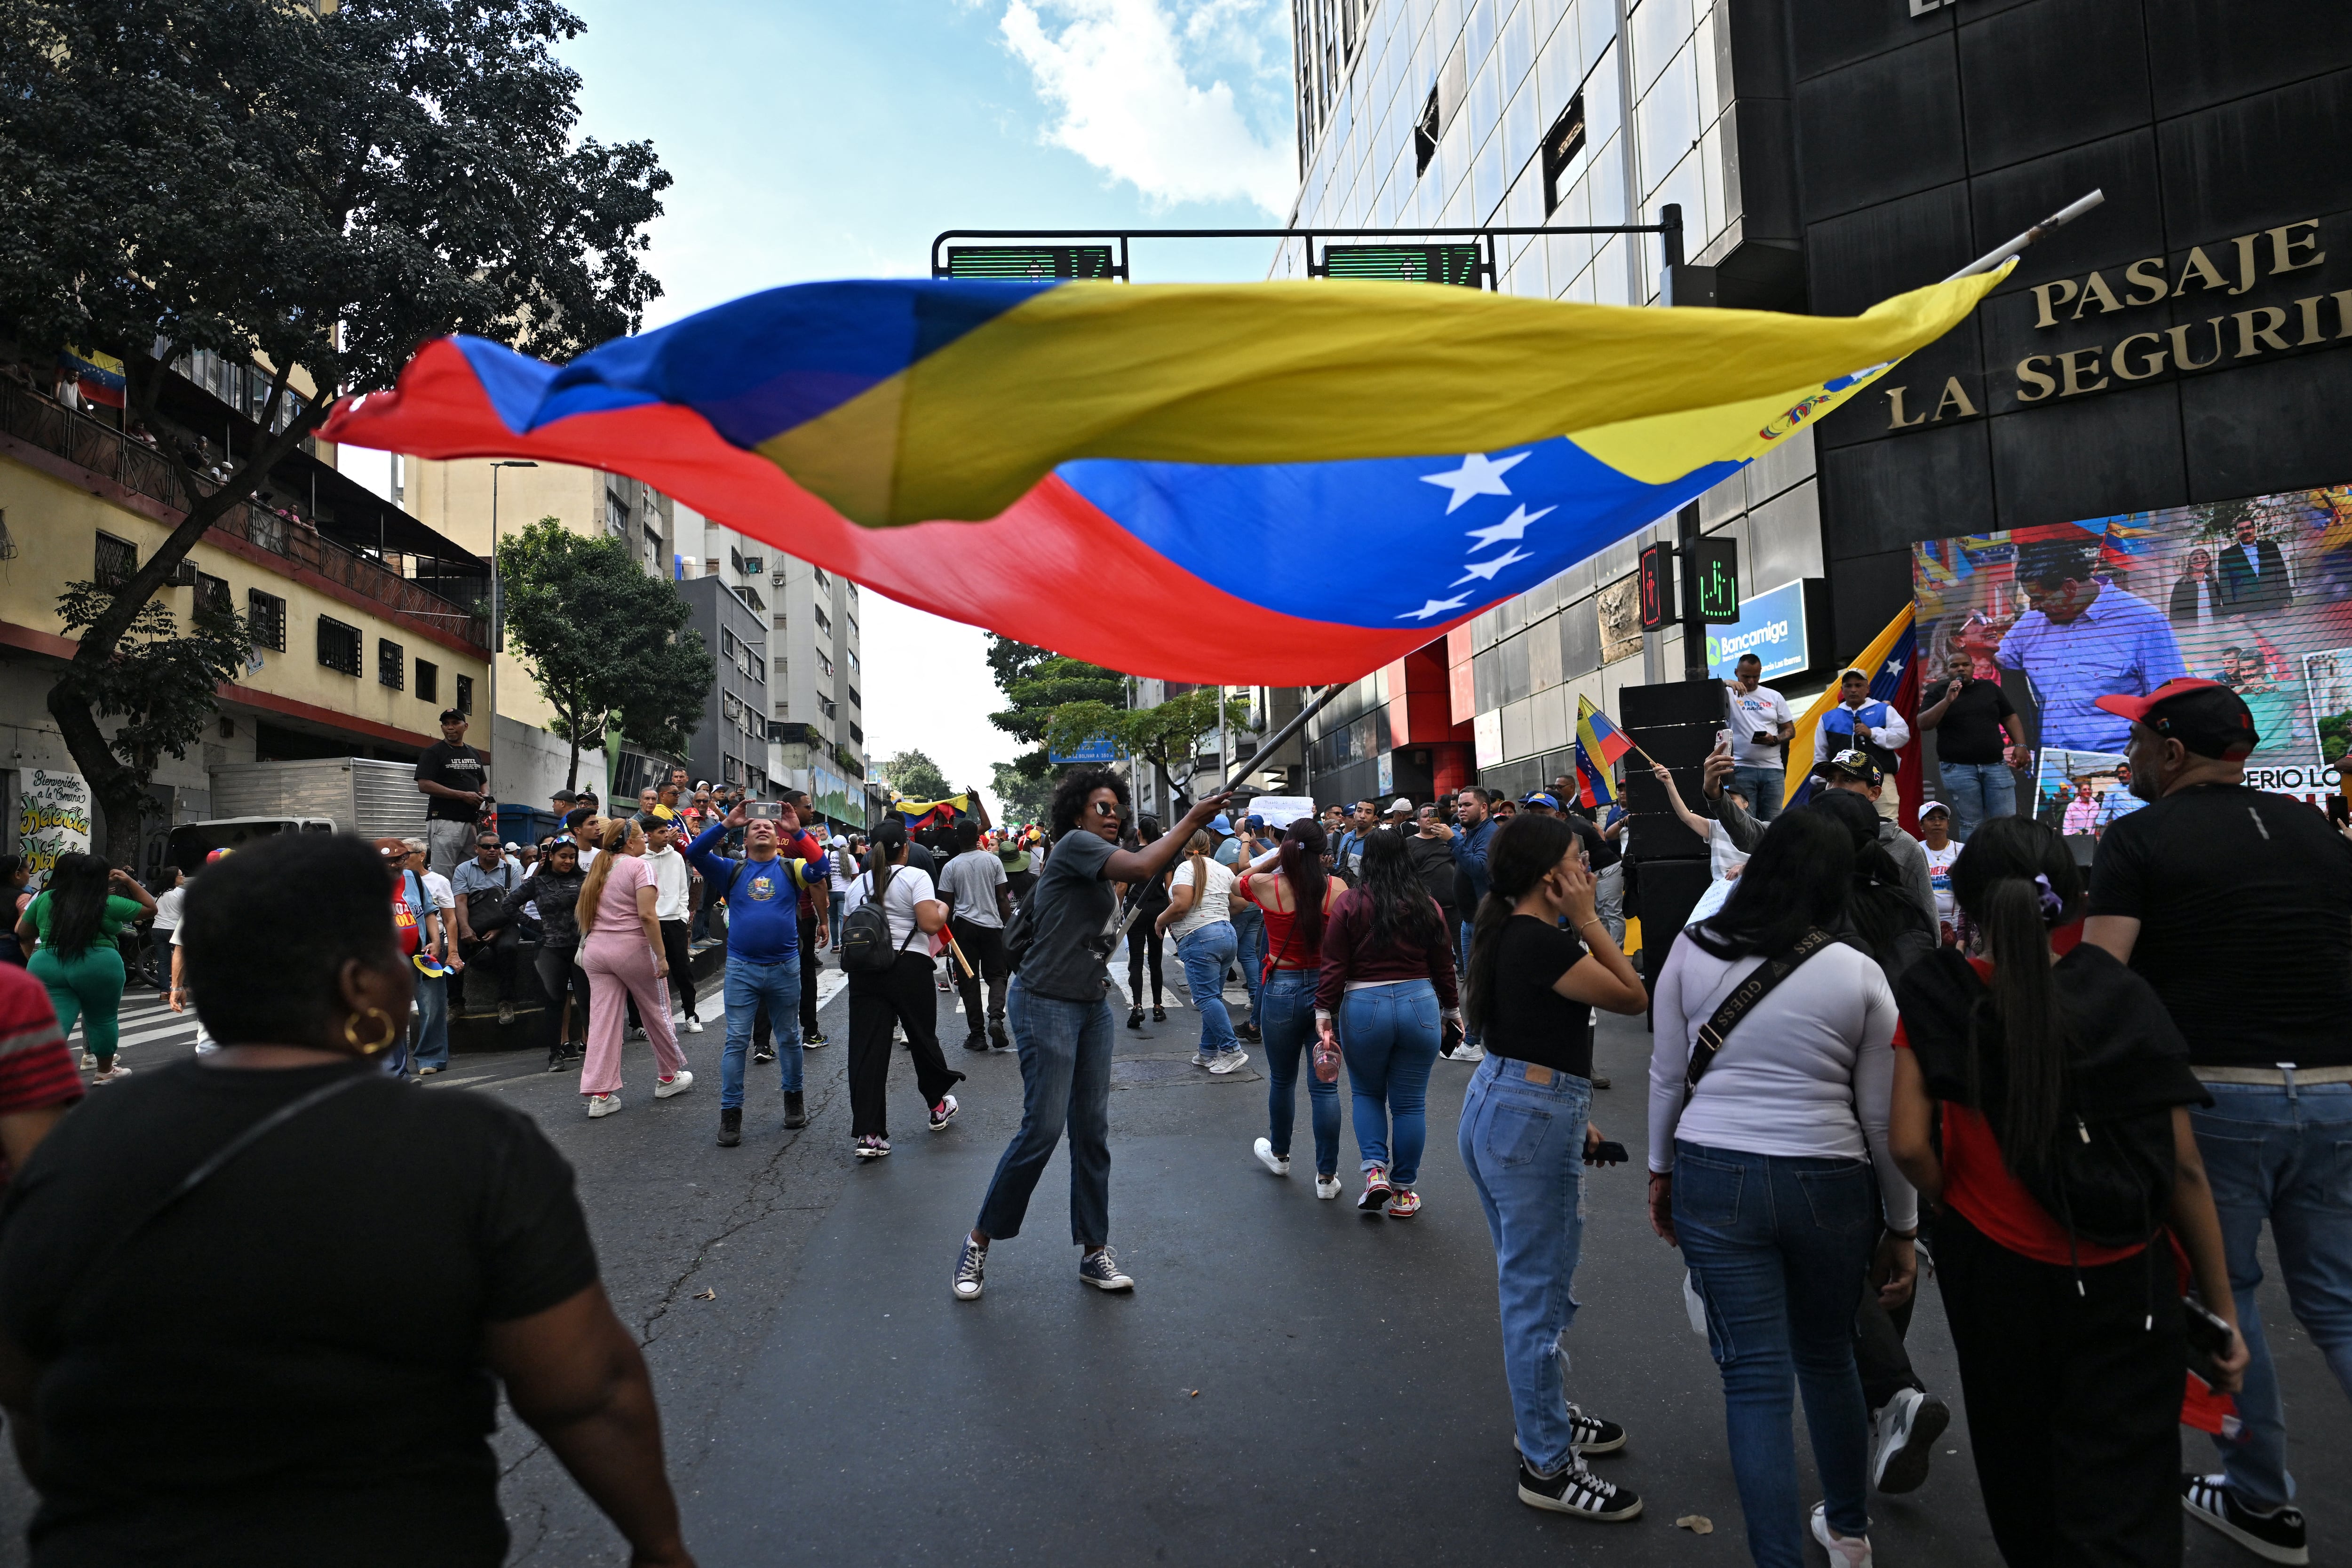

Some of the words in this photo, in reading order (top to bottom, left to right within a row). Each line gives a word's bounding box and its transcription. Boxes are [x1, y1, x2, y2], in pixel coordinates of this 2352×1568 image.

[2031, 218, 2325, 329] PASAJE
[1886, 377, 1979, 430] LA
[1721, 620, 1788, 655] Bancamiga
[33, 770, 83, 792] Bienvenidos
[46, 787, 52, 800] la
[54, 787, 86, 803] Comuna
[2243, 769, 2303, 789] ERIO
[20, 795, 90, 836] Herencia
[1794, 931, 1830, 955] UESS
[1717, 981, 1762, 1027] GUESS
